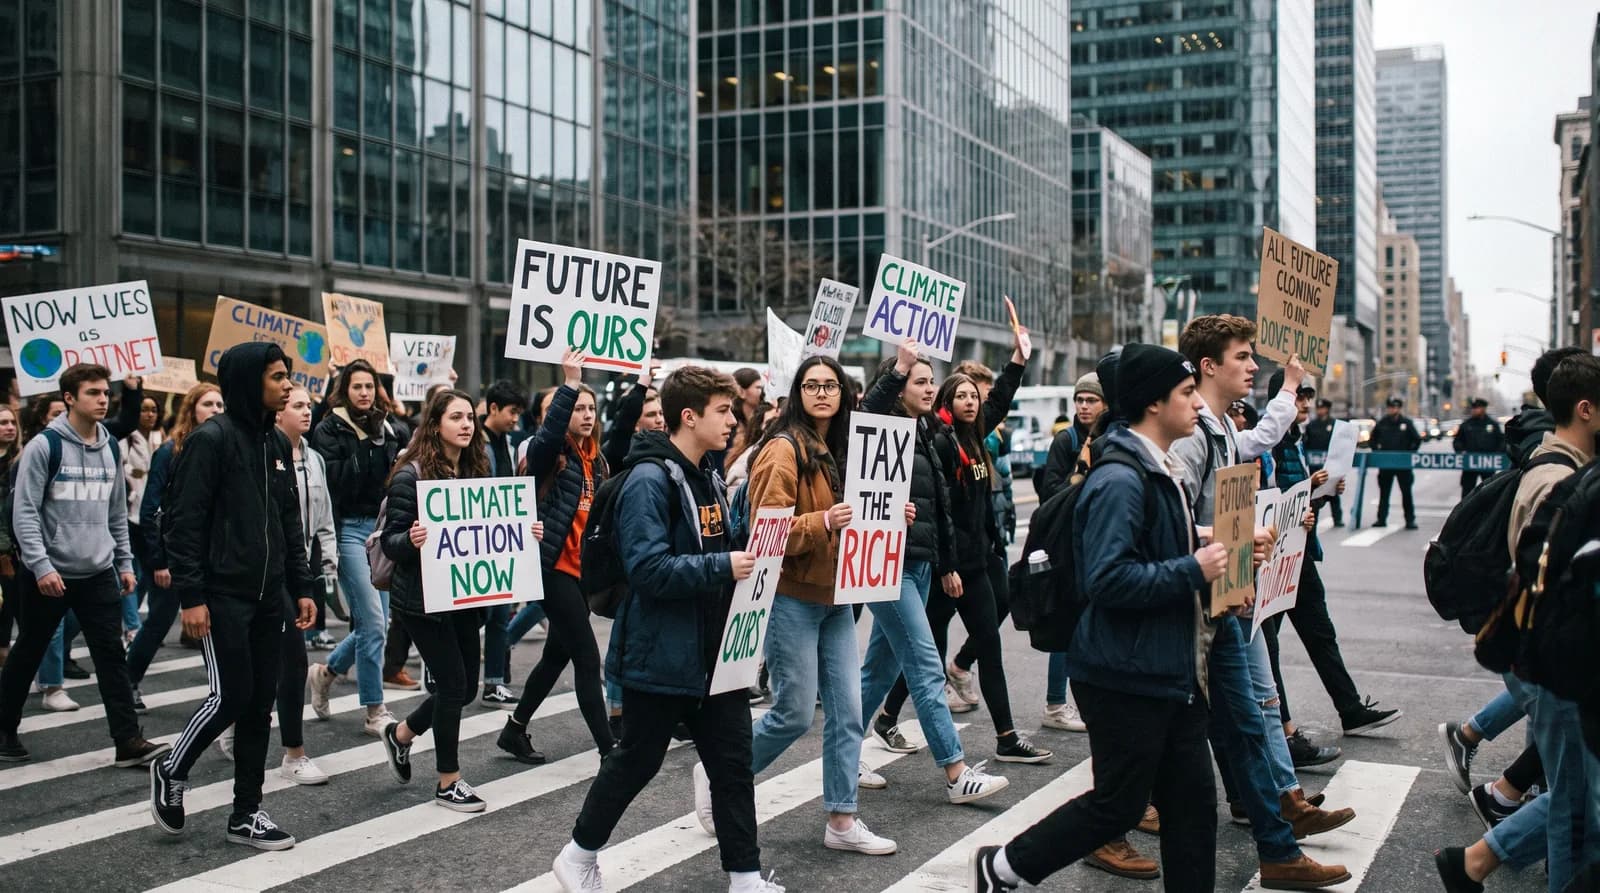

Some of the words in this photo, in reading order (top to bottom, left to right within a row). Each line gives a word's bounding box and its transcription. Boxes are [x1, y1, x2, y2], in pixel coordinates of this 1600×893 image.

[521, 249, 654, 309] FUTURE
[1266, 236, 1286, 266] ALL
[1291, 245, 1332, 287] FUTURE
[881, 262, 959, 312] CLIMATE
[1276, 269, 1321, 308] CLONING
[10, 296, 76, 334] NOW
[231, 304, 303, 340] CLIMATE
[870, 296, 955, 351] ACTION
[1283, 300, 1293, 319] TO
[79, 328, 100, 342] as
[519, 304, 554, 349] IS
[567, 310, 648, 362] OURS
[855, 425, 910, 483] TAX
[1411, 454, 1464, 468] POLICE
[1469, 455, 1503, 469] LINE
[425, 484, 528, 522] CLIMATE
[859, 491, 893, 521] THE
[437, 522, 524, 560] ACTION
[749, 516, 793, 559] FUTURE
[450, 557, 515, 598] NOW
[840, 529, 903, 589] RICH
[751, 567, 768, 601] IS
[722, 608, 765, 664] OURS
